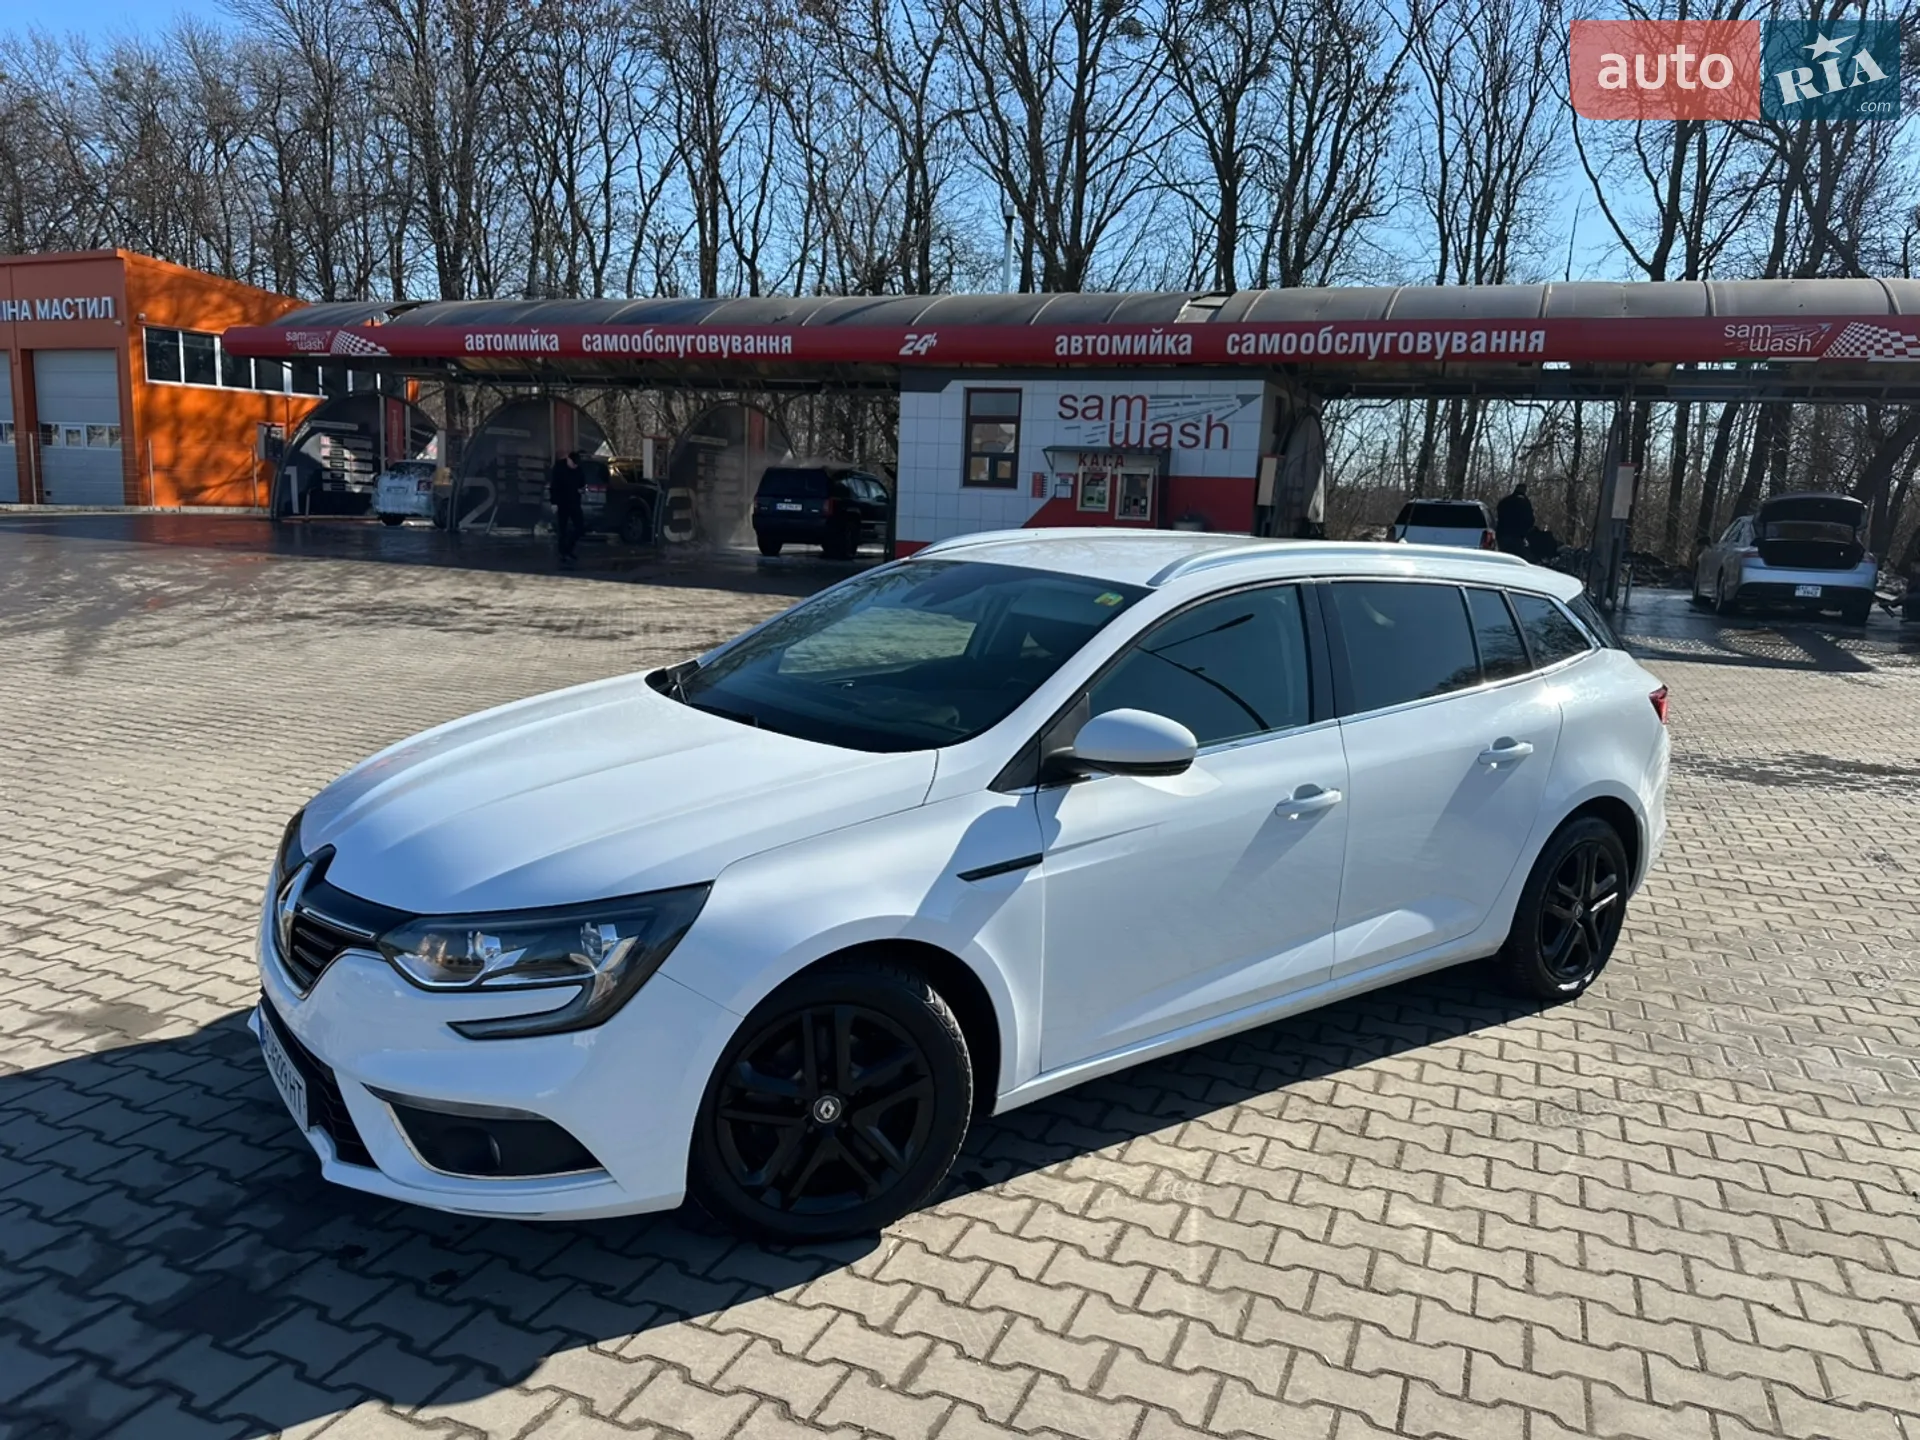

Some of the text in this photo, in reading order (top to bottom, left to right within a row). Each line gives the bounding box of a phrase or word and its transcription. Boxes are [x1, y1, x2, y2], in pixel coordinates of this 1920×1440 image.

[0, 296, 113, 321] ІНА МАСТИЛ
[286, 331, 307, 341] sam
[464, 328, 792, 358] автомийка самообслуговування
[1055, 326, 1546, 361] автомийка самообслуговування
[1724, 324, 1772, 338] sam
[1750, 334, 1812, 352] wash
[297, 339, 325, 351] wash
[1058, 394, 1149, 421] sam
[1109, 414, 1229, 450] wash
